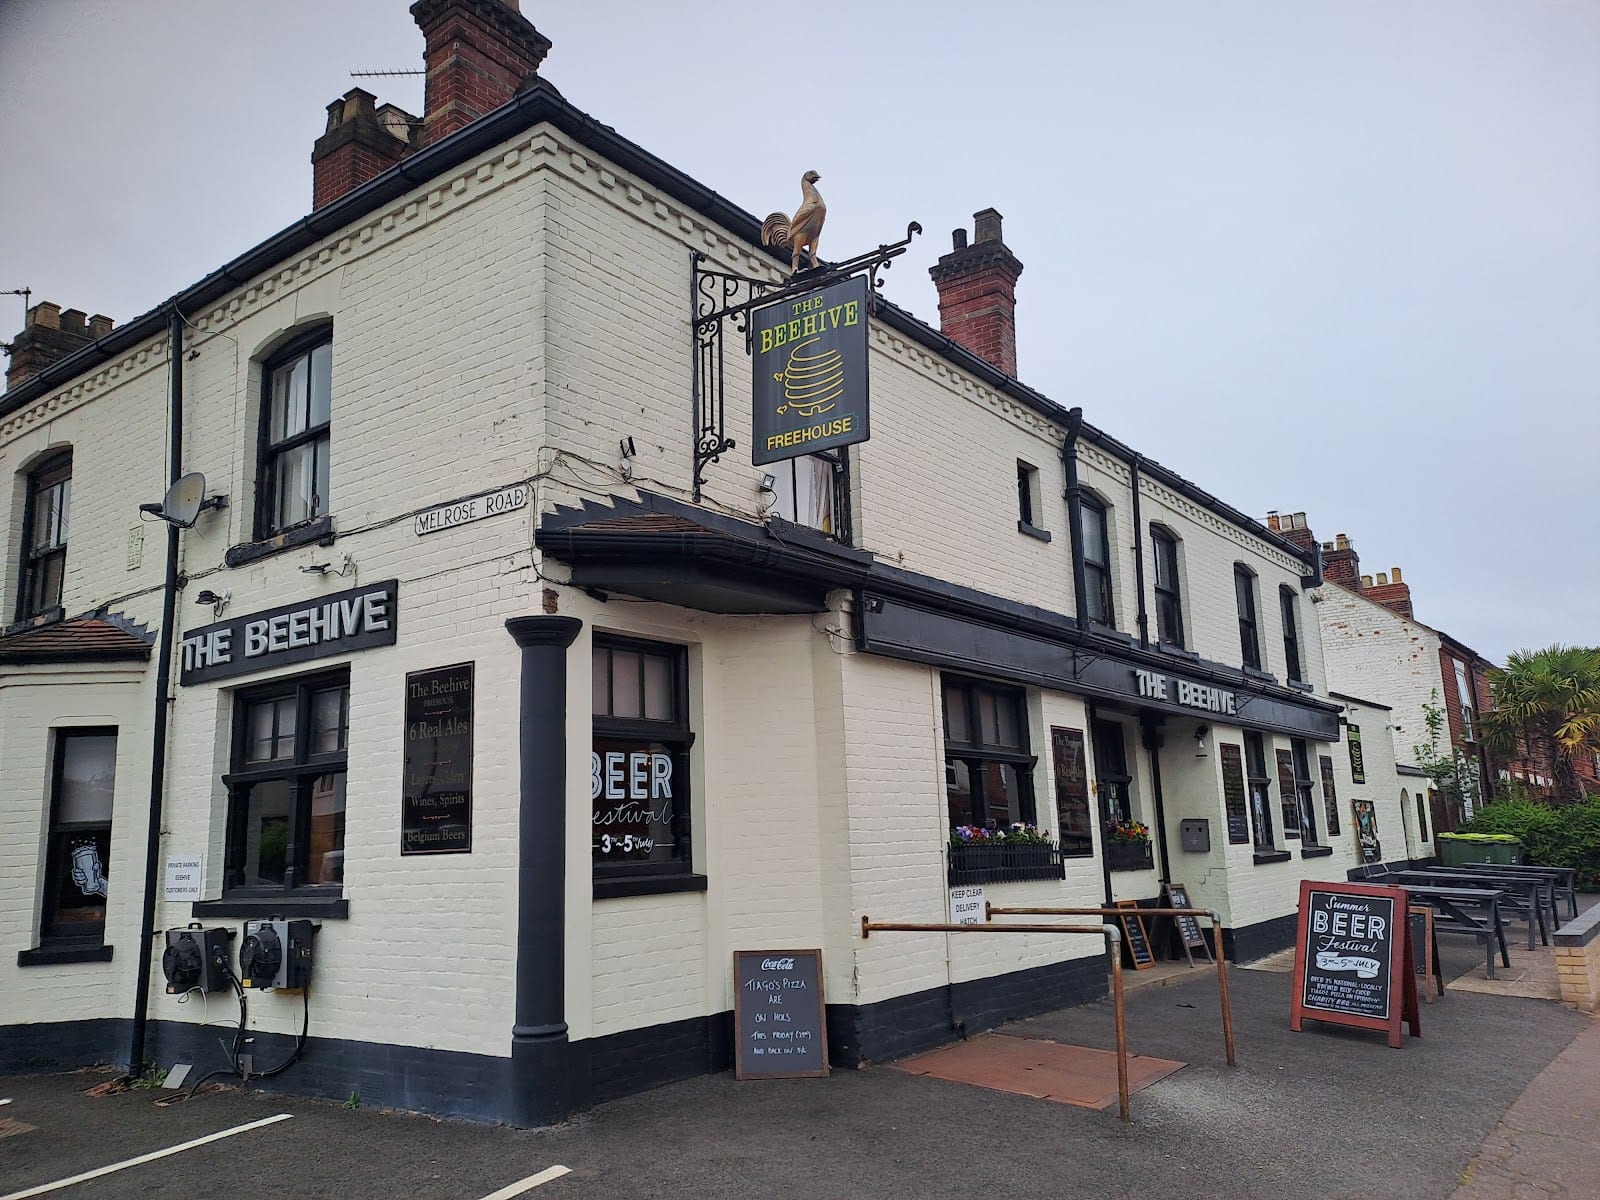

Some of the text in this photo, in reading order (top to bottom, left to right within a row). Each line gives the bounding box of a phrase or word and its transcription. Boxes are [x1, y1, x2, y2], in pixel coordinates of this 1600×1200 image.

[792, 296, 823, 315] THE
[760, 300, 858, 354] BEEHIVE
[767, 417, 852, 450] FREEHOUSE
[418, 488, 524, 532] MELROSE ROAD
[182, 590, 389, 672] THE BEEHIVE
[410, 676, 470, 698] The Beehive
[1136, 669, 1237, 715] THE BEEHIVE
[410, 716, 468, 741] 6 Real Ales
[410, 793, 464, 808] Wines, Spirits
[592, 801, 674, 825] estival
[408, 828, 466, 844] Belgium Beers
[952, 888, 982, 899] KEEP CLEAR
[956, 902, 980, 912] DELIVERY
[1326, 896, 1371, 912] Summer
[1313, 910, 1386, 940] BEER
[1316, 934, 1378, 953] Festival
[1353, 959, 1376, 969] JULY
[1361, 983, 1382, 991] LOCALLY
[769, 994, 782, 1004] ARE
[1308, 994, 1335, 1004] CHARITY
[755, 1012, 790, 1022] ON HOLS
[751, 1031, 767, 1040] THIS
[773, 1031, 793, 1042] FRIDAY
